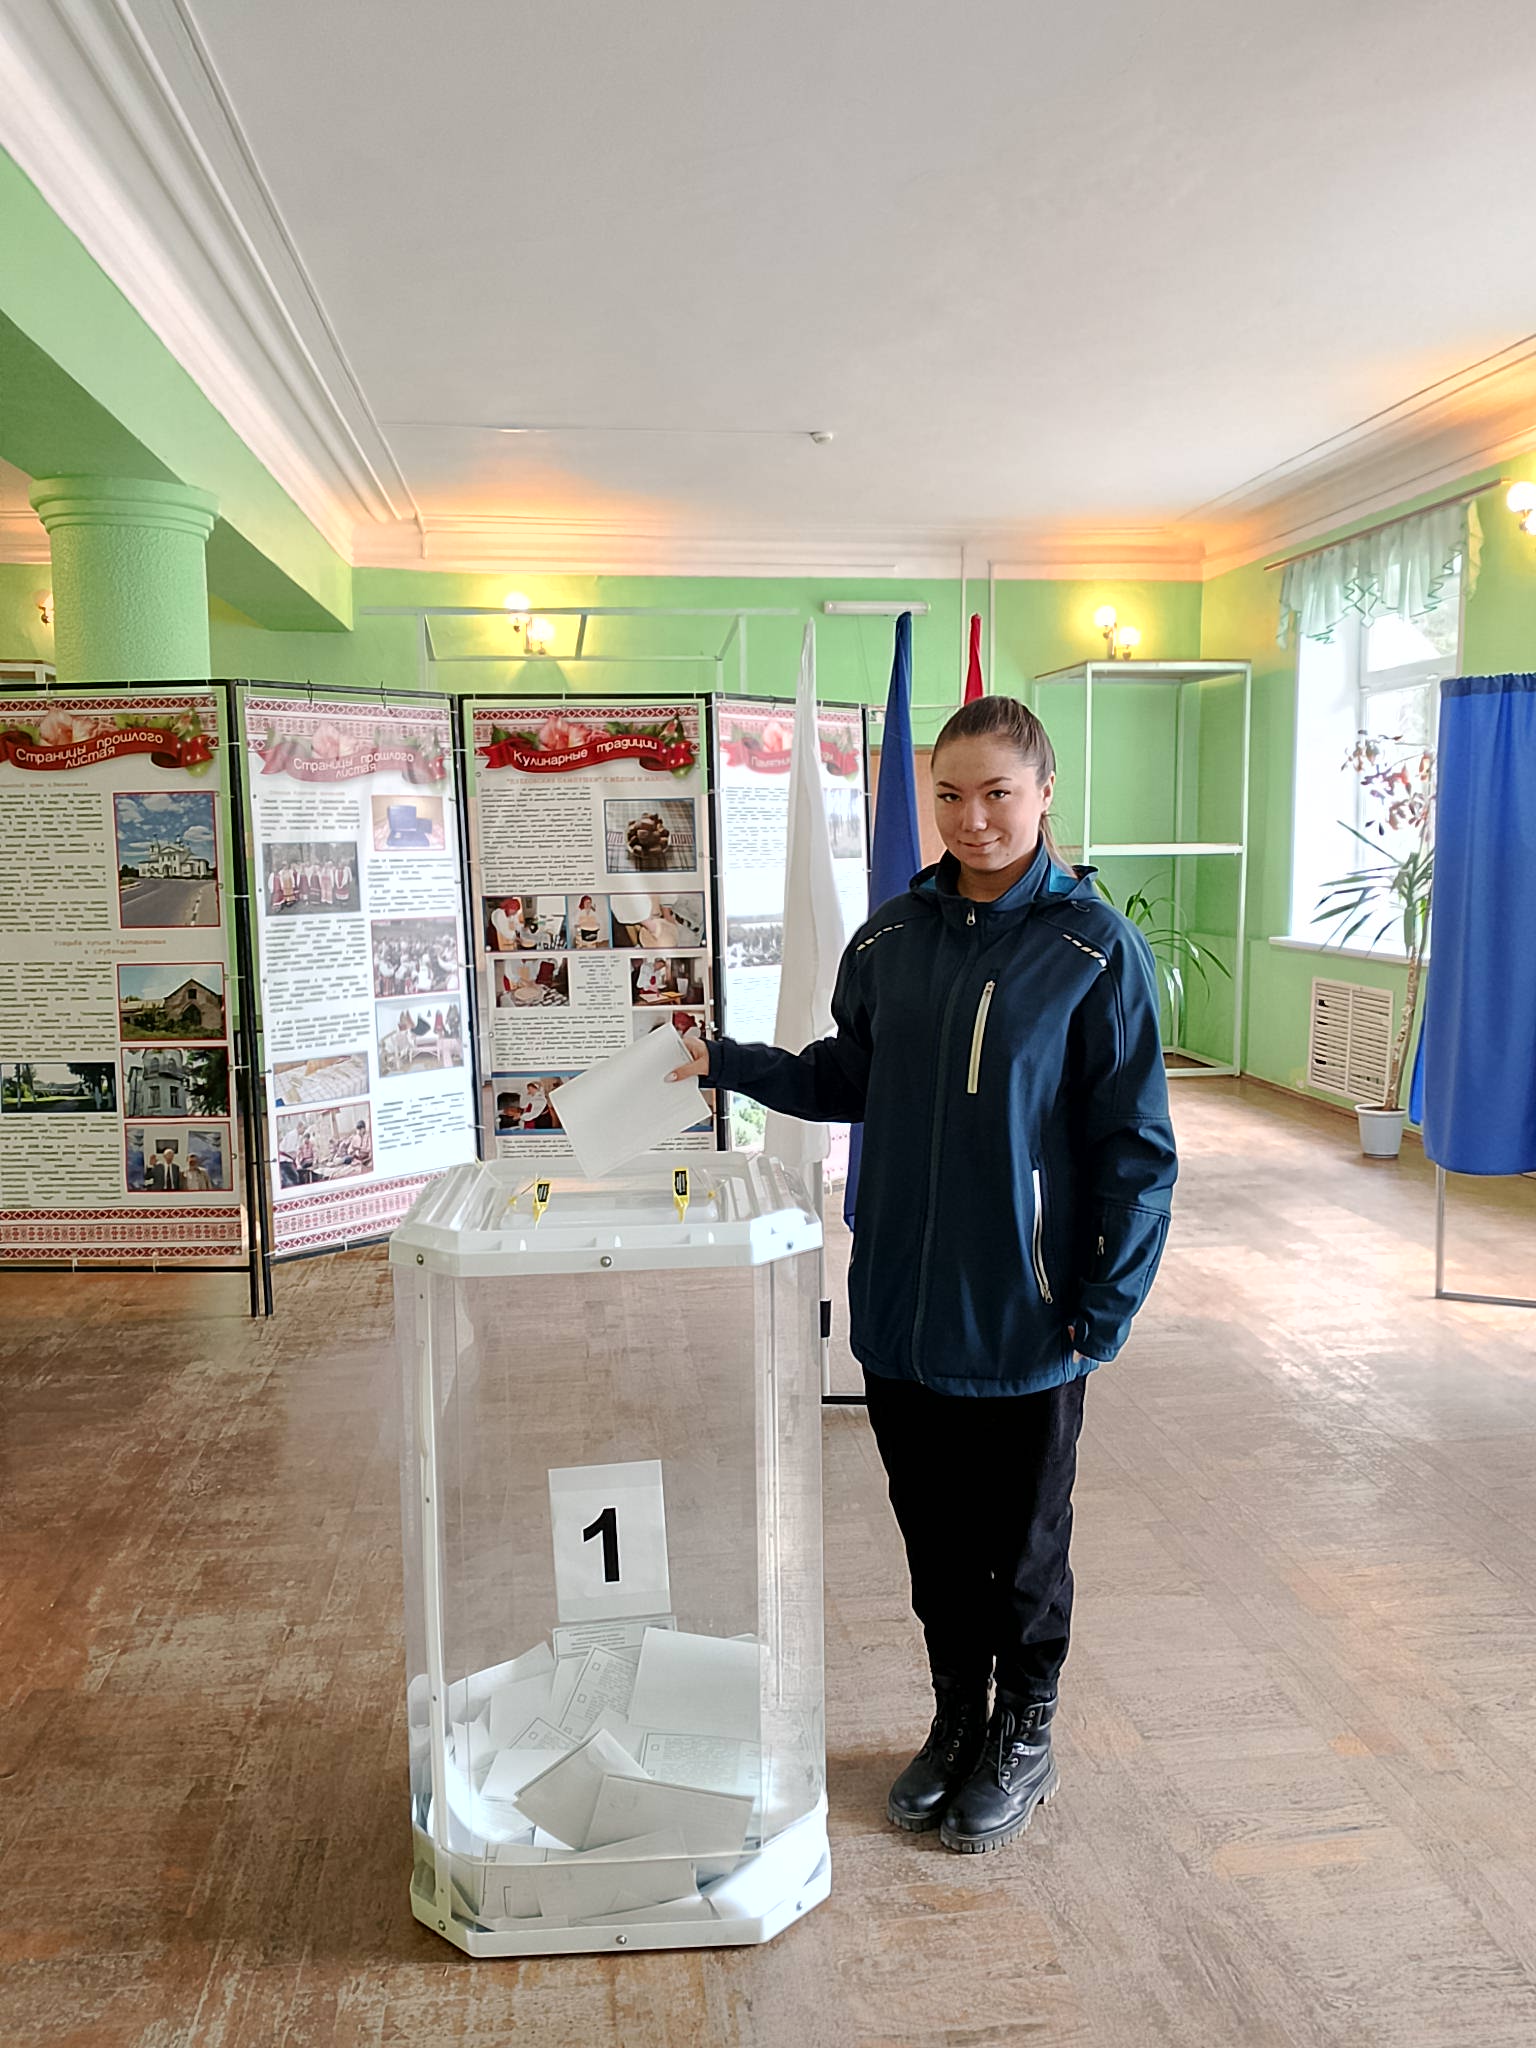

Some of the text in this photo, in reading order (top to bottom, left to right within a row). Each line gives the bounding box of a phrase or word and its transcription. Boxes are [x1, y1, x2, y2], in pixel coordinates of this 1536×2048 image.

[15, 731, 164, 766] Страницы прошлого
[65, 746, 116, 769] листая
[513, 738, 658, 767] Кулинарные традиции
[293, 751, 415, 773] Страницы прошлого
[336, 762, 377, 779] листая
[582, 1507, 620, 1583] 1
